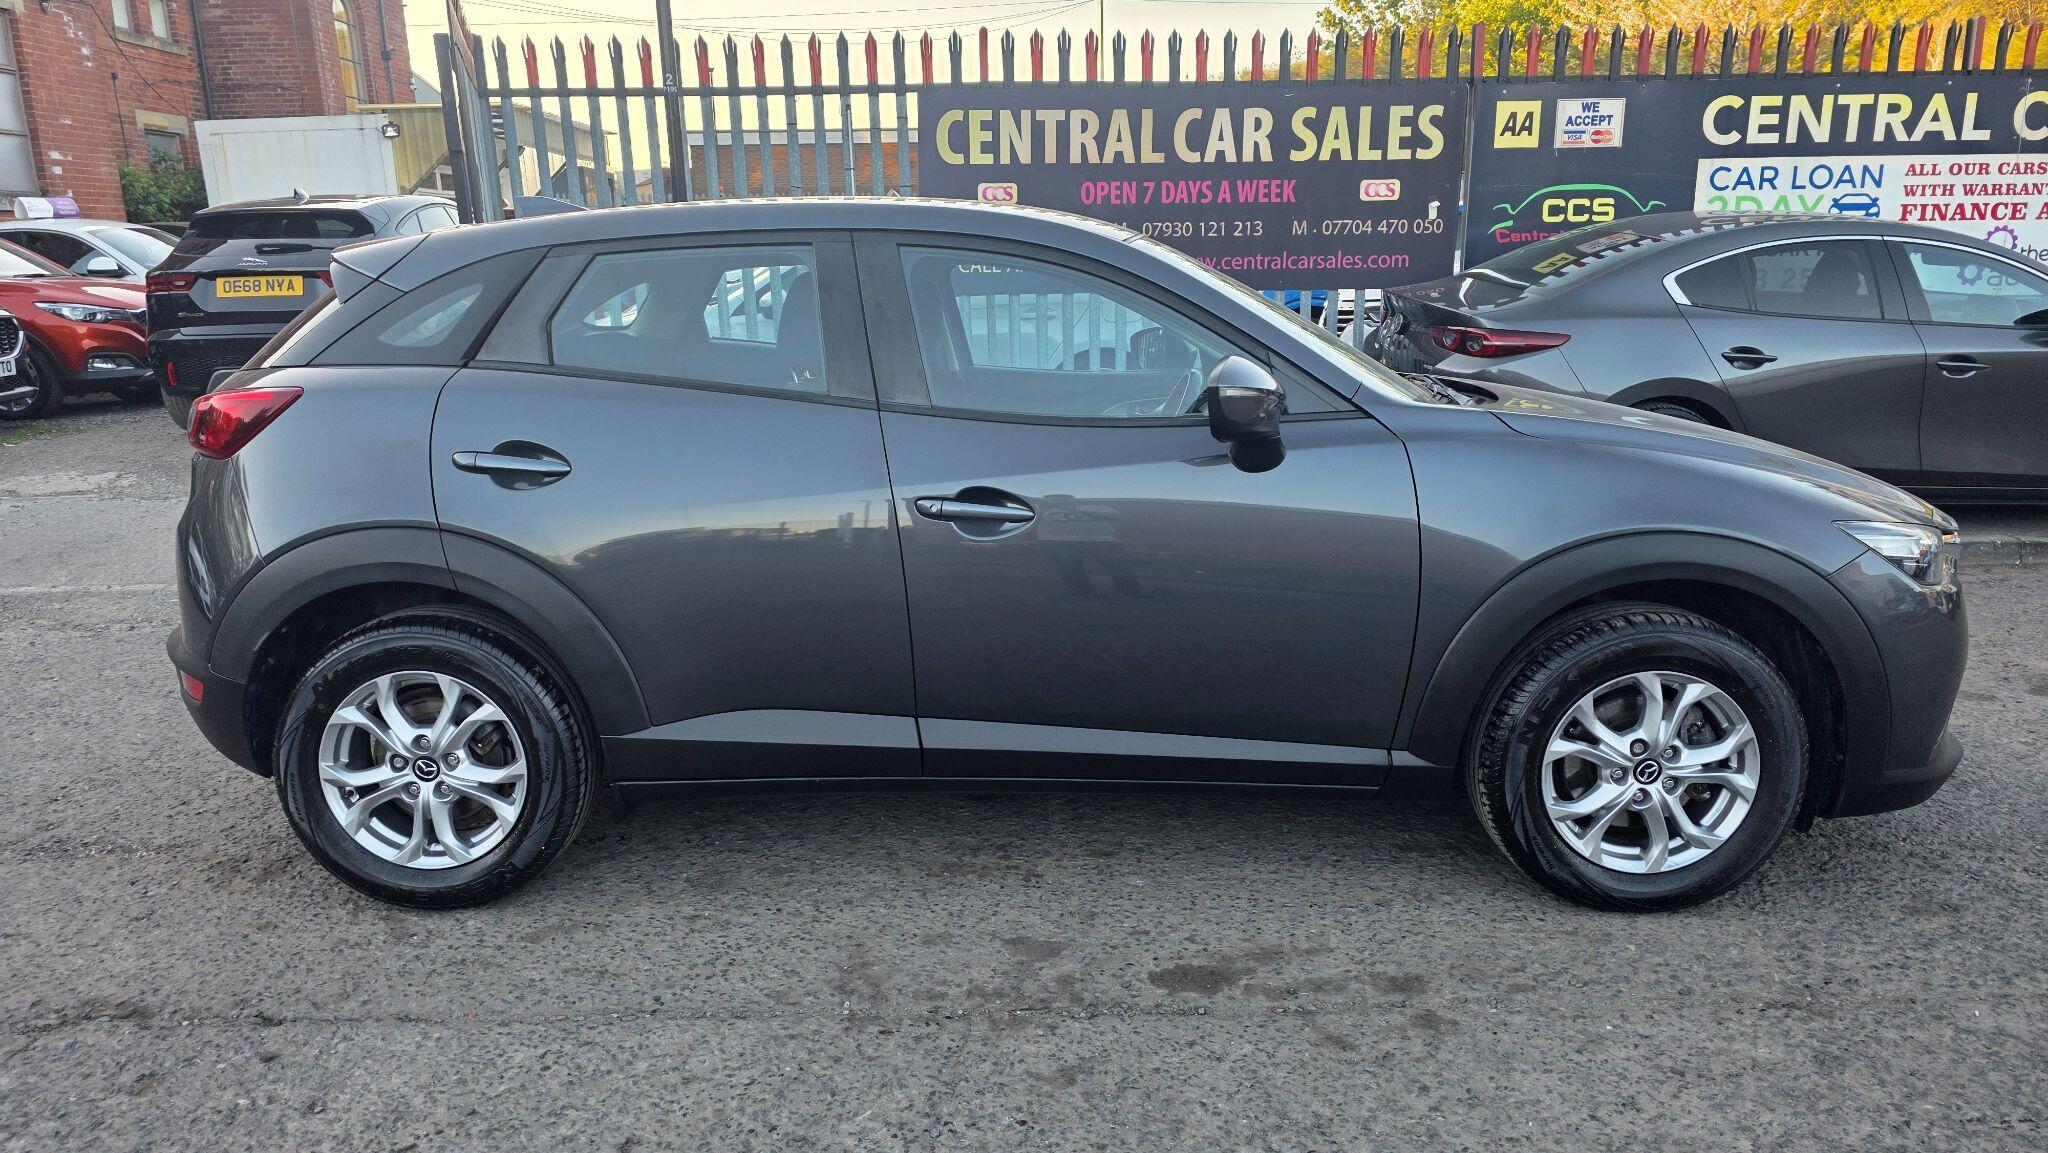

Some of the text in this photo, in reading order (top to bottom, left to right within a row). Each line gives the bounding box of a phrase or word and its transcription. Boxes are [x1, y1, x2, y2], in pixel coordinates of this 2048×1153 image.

[1581, 102, 1600, 113] WE
[1500, 111, 1534, 136] AA
[1565, 115, 1613, 127] ACCEPT
[1702, 92, 1991, 145] CENTRAL
[936, 104, 1445, 165] CENTRAL CAR SALES
[1904, 161, 2048, 176] ALL OUR CARS
[1709, 164, 1884, 191] CAR LOAN
[981, 186, 1014, 201] CCS
[1081, 179, 1296, 205] OPEN 7 DAYS A WEEK
[1363, 182, 1396, 198] CCS
[1903, 184, 1955, 197] WITH
[1541, 197, 1615, 223] CCS
[1899, 202, 2028, 221] FINANCE
[1142, 221, 1193, 237] 07930
[1199, 221, 1225, 236] 121
[1233, 220, 1263, 236] 213
[1322, 219, 1373, 235] 07704
[1377, 219, 1408, 234] 470
[1413, 218, 1443, 234] 050
[222, 278, 296, 293] OE68 NYA
